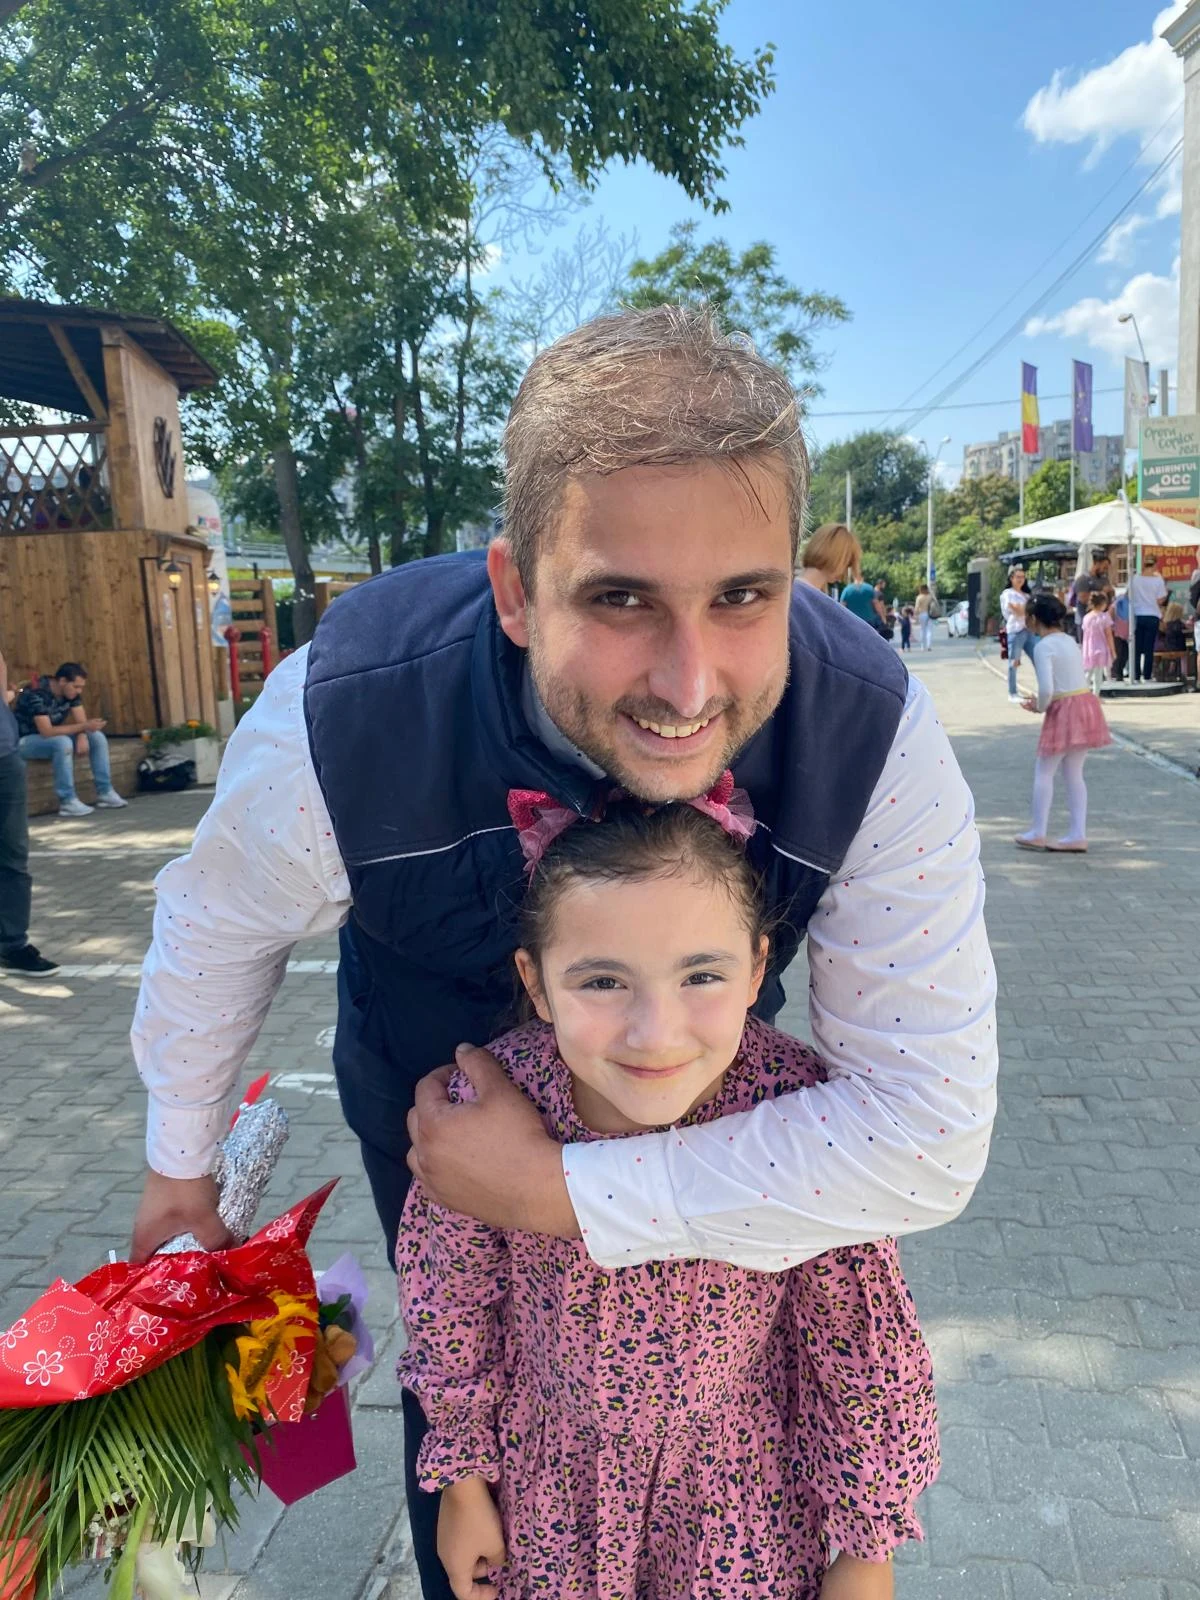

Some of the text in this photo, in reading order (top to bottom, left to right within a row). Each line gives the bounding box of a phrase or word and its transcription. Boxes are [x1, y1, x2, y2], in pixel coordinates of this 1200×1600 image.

[1143, 463, 1197, 476] LABIRINTUL
[1160, 474, 1191, 485] OCC
[1161, 563, 1191, 578] BILE
